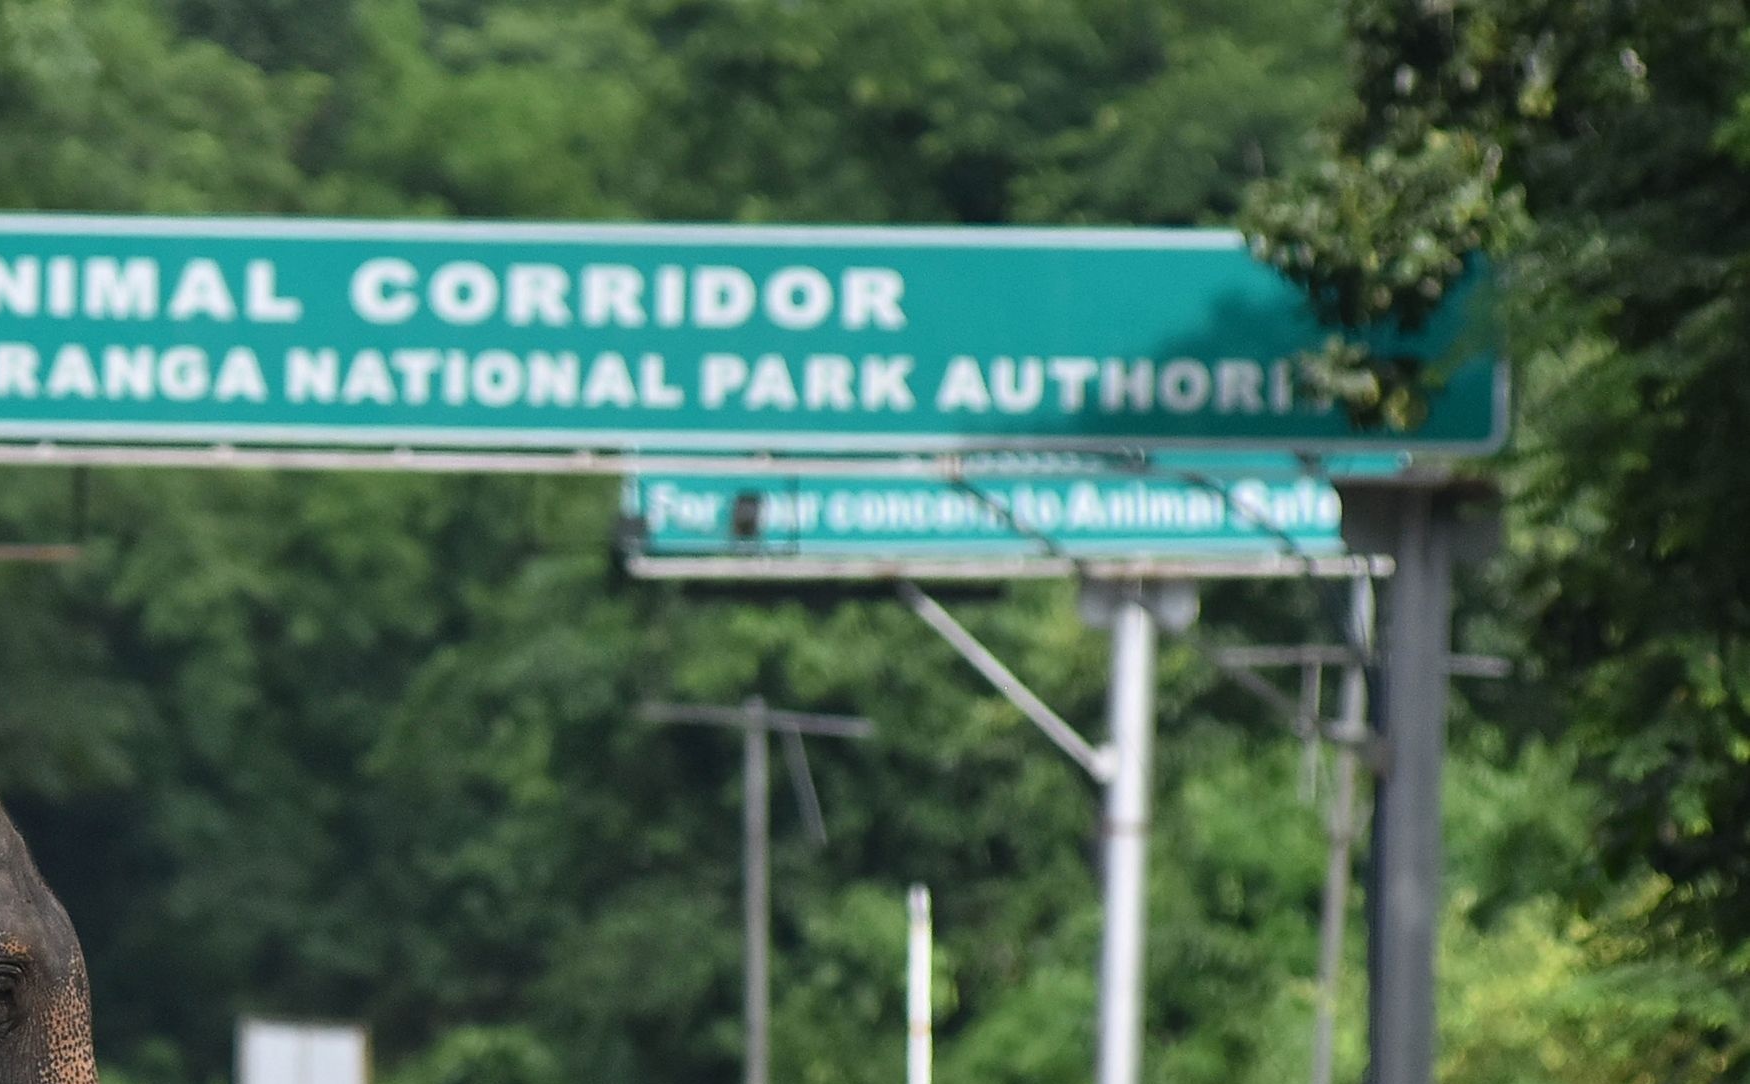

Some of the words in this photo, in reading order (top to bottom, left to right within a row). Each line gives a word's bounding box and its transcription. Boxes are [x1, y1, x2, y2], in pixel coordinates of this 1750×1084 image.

[350, 257, 906, 331] CORRIDOR
[284, 347, 684, 407] NATIONAL
[700, 353, 916, 411] PARK
[936, 355, 1335, 413] AUTHORI
[646, 481, 718, 532] For
[735, 489, 820, 532] ur
[1066, 480, 1226, 531] Animal
[1229, 477, 1343, 532] Safe
